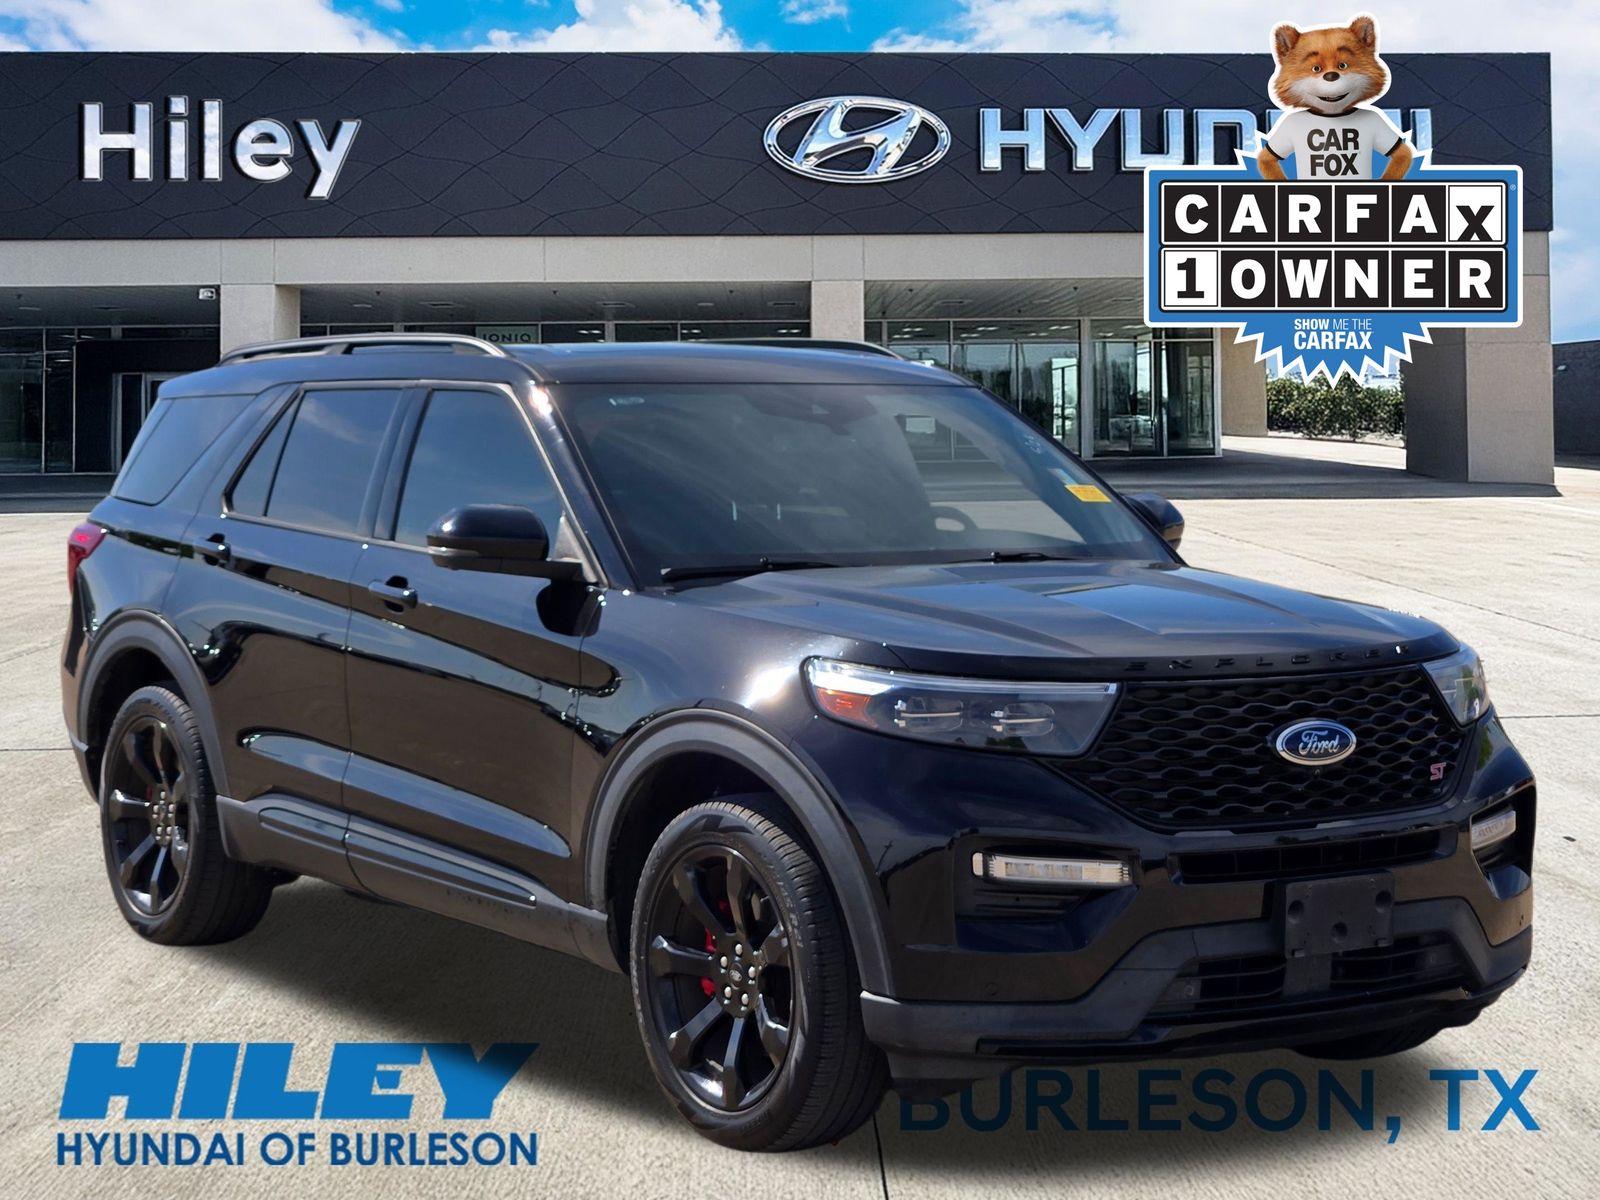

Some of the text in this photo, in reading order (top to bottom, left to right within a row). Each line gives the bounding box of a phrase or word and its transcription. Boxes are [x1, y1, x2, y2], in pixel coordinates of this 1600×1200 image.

[80, 95, 361, 200] Hiley
[979, 108, 1432, 172] HYUNI
[1298, 730, 1340, 755] Ford
[1430, 761, 1446, 781] ST
